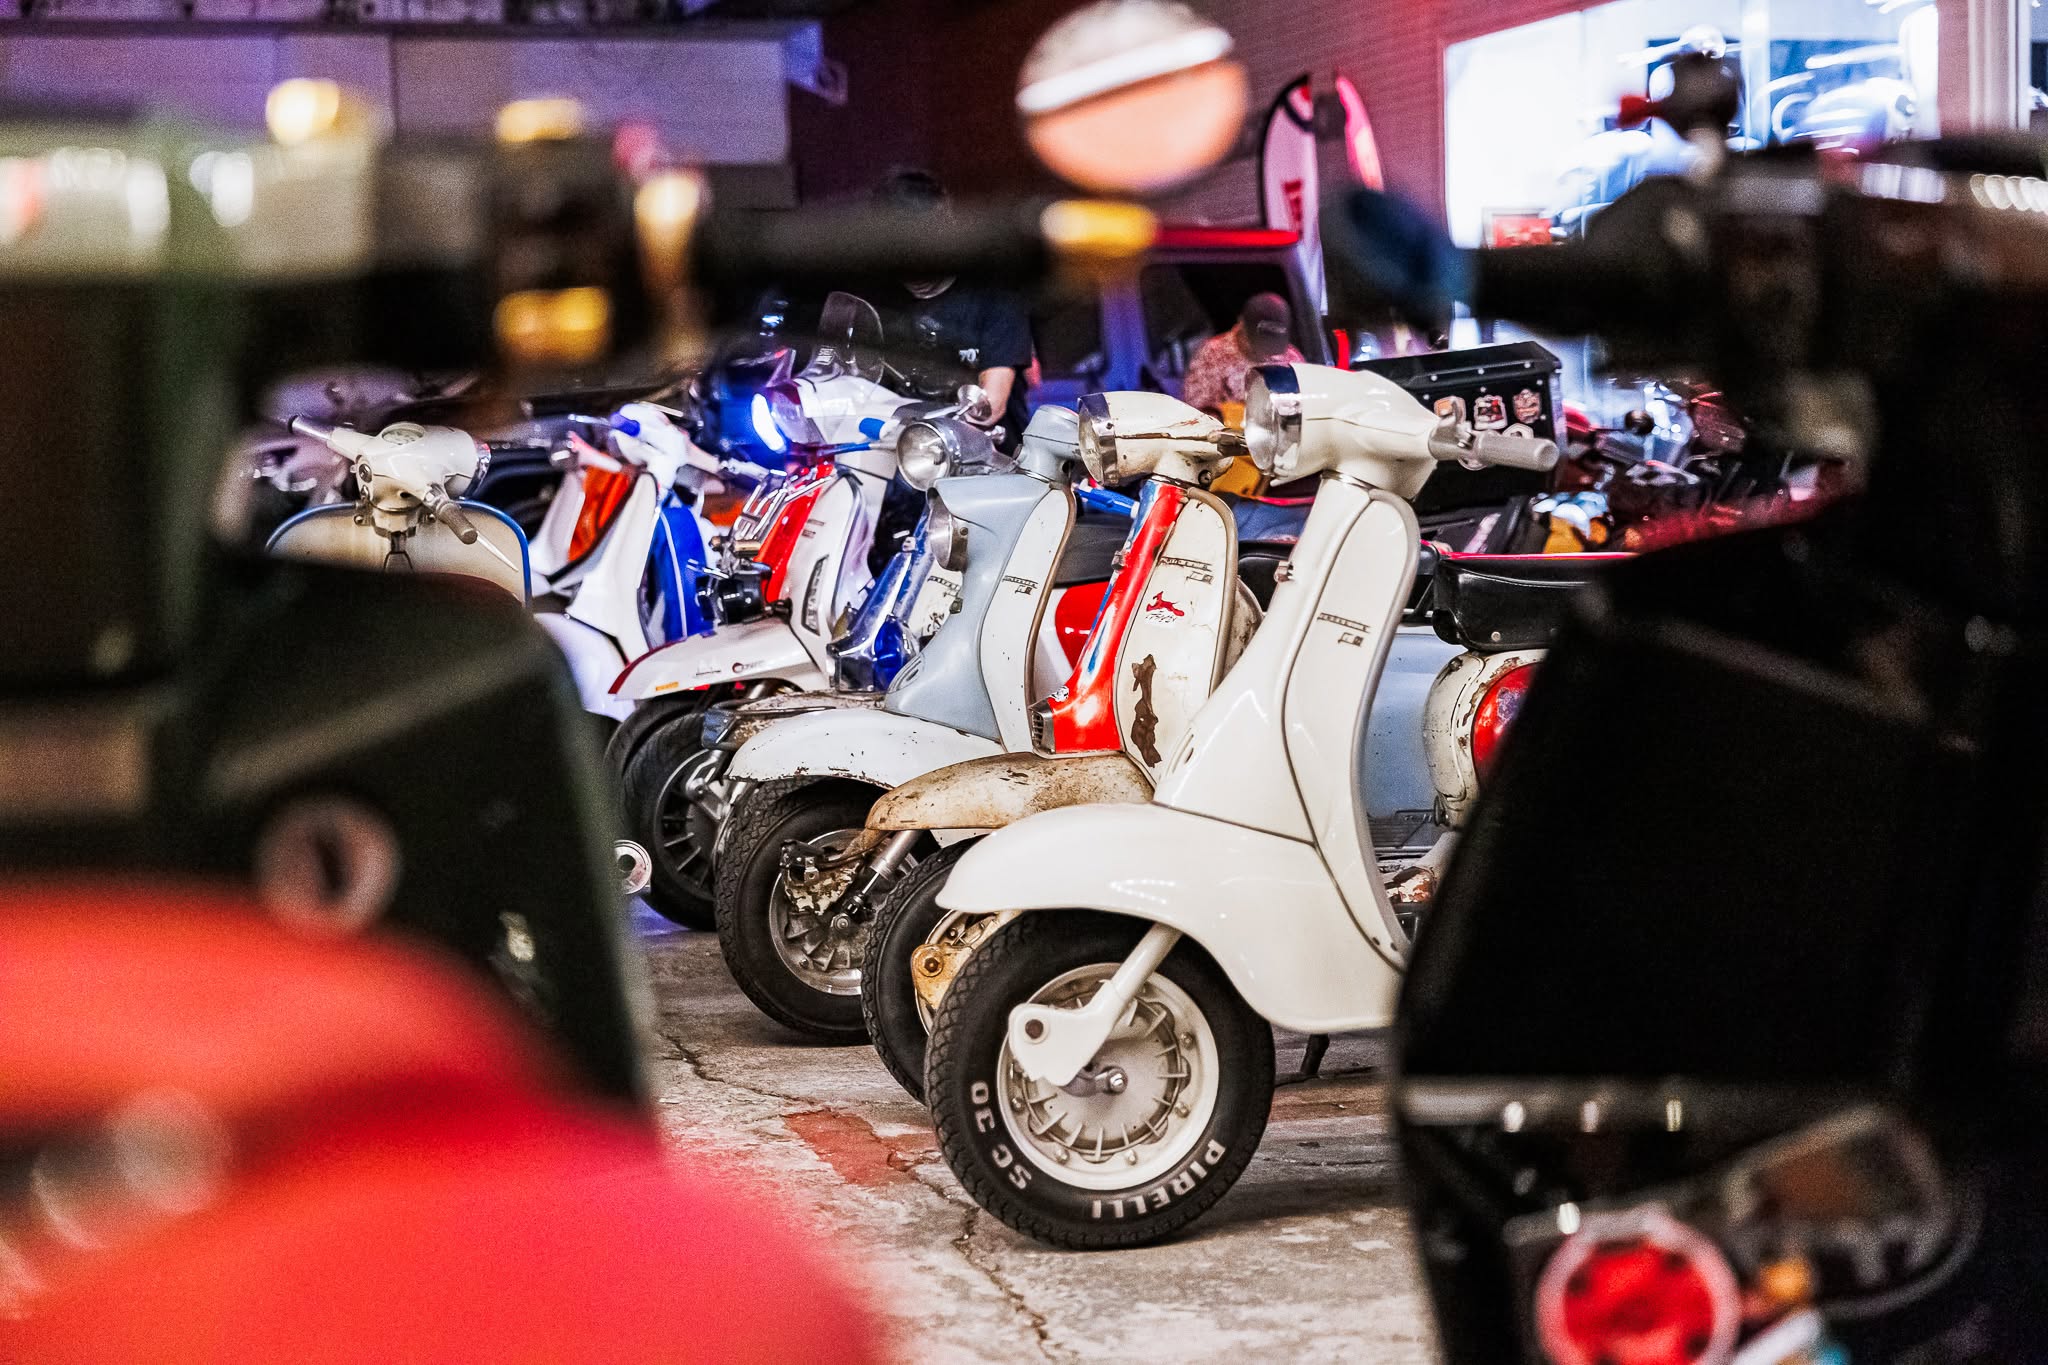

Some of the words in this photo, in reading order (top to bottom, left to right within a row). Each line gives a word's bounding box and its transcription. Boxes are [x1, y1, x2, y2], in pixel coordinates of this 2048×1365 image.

[970, 1081, 995, 1133] 30
[992, 1143, 1032, 1190] SC
[1091, 1138, 1226, 1219] PIRELLI
